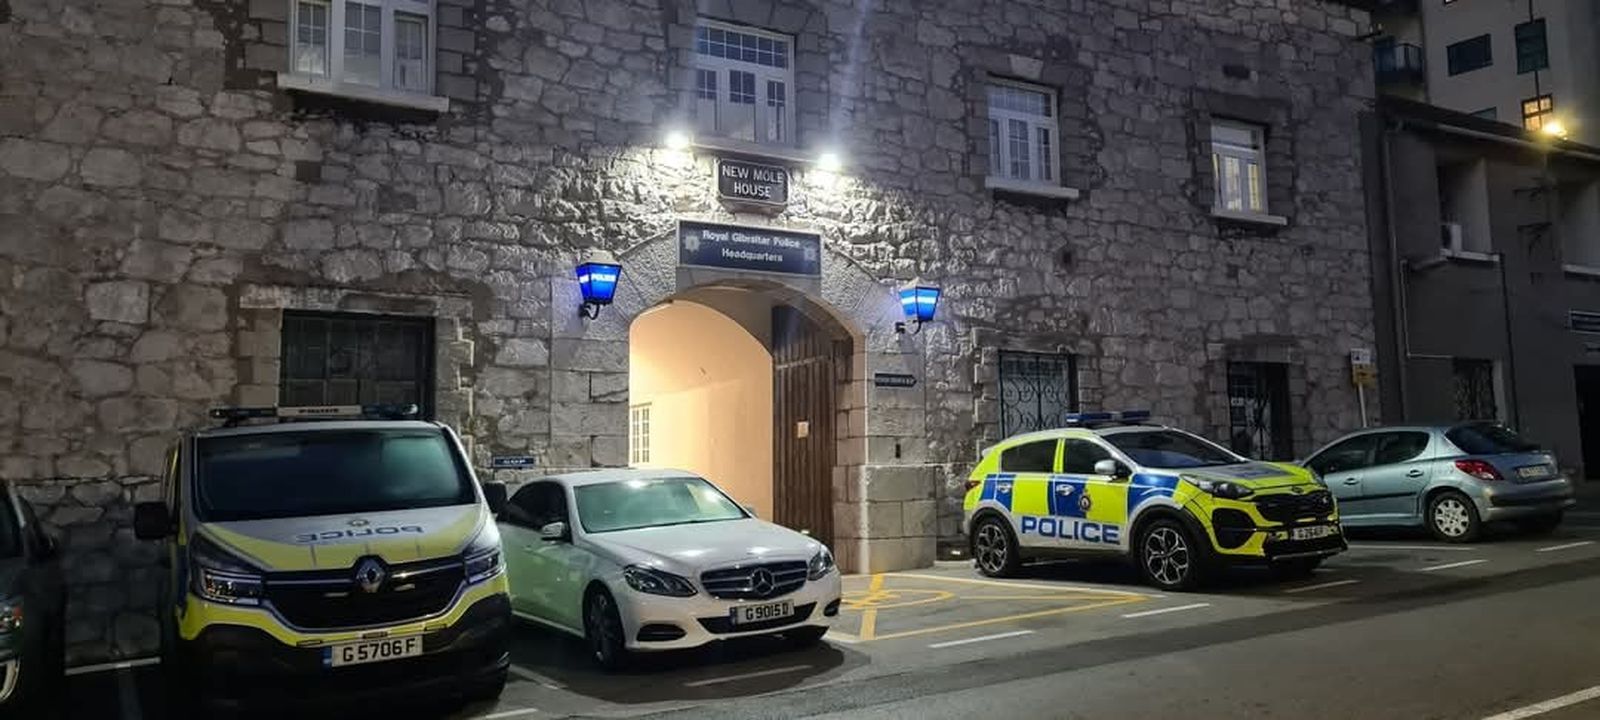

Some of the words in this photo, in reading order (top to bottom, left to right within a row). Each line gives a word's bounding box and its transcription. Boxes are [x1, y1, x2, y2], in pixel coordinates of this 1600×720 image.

[722, 165, 749, 179] NEW
[753, 170, 784, 183] MOLE
[733, 181, 772, 198] HOUSE
[702, 229, 729, 242] Royal
[731, 233, 771, 246] Gibraltar
[773, 236, 801, 248] Police
[721, 248, 783, 262] Headquarters
[1021, 515, 1120, 545] POLICE
[745, 607, 754, 620] G
[755, 604, 781, 619] 9015
[782, 602, 789, 615] D
[343, 647, 354, 662] G
[358, 641, 402, 660] 5706
[405, 638, 416, 653] F
